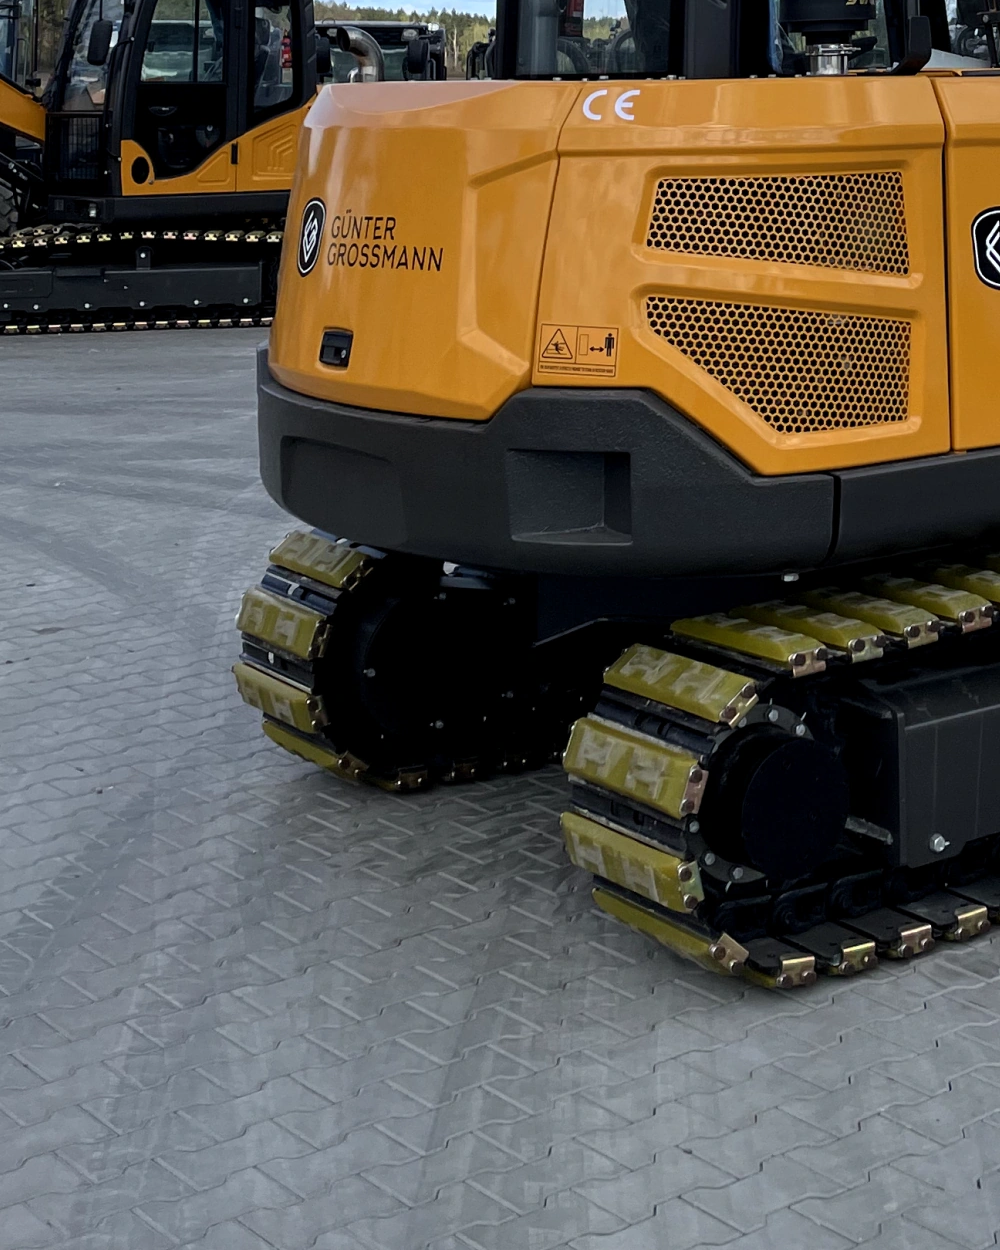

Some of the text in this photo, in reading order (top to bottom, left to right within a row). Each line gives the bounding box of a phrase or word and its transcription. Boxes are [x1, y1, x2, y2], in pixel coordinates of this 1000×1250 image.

[582, 89, 641, 121] CE
[331, 209, 396, 240] GÜNTER
[327, 243, 444, 271] GROSSMANN
